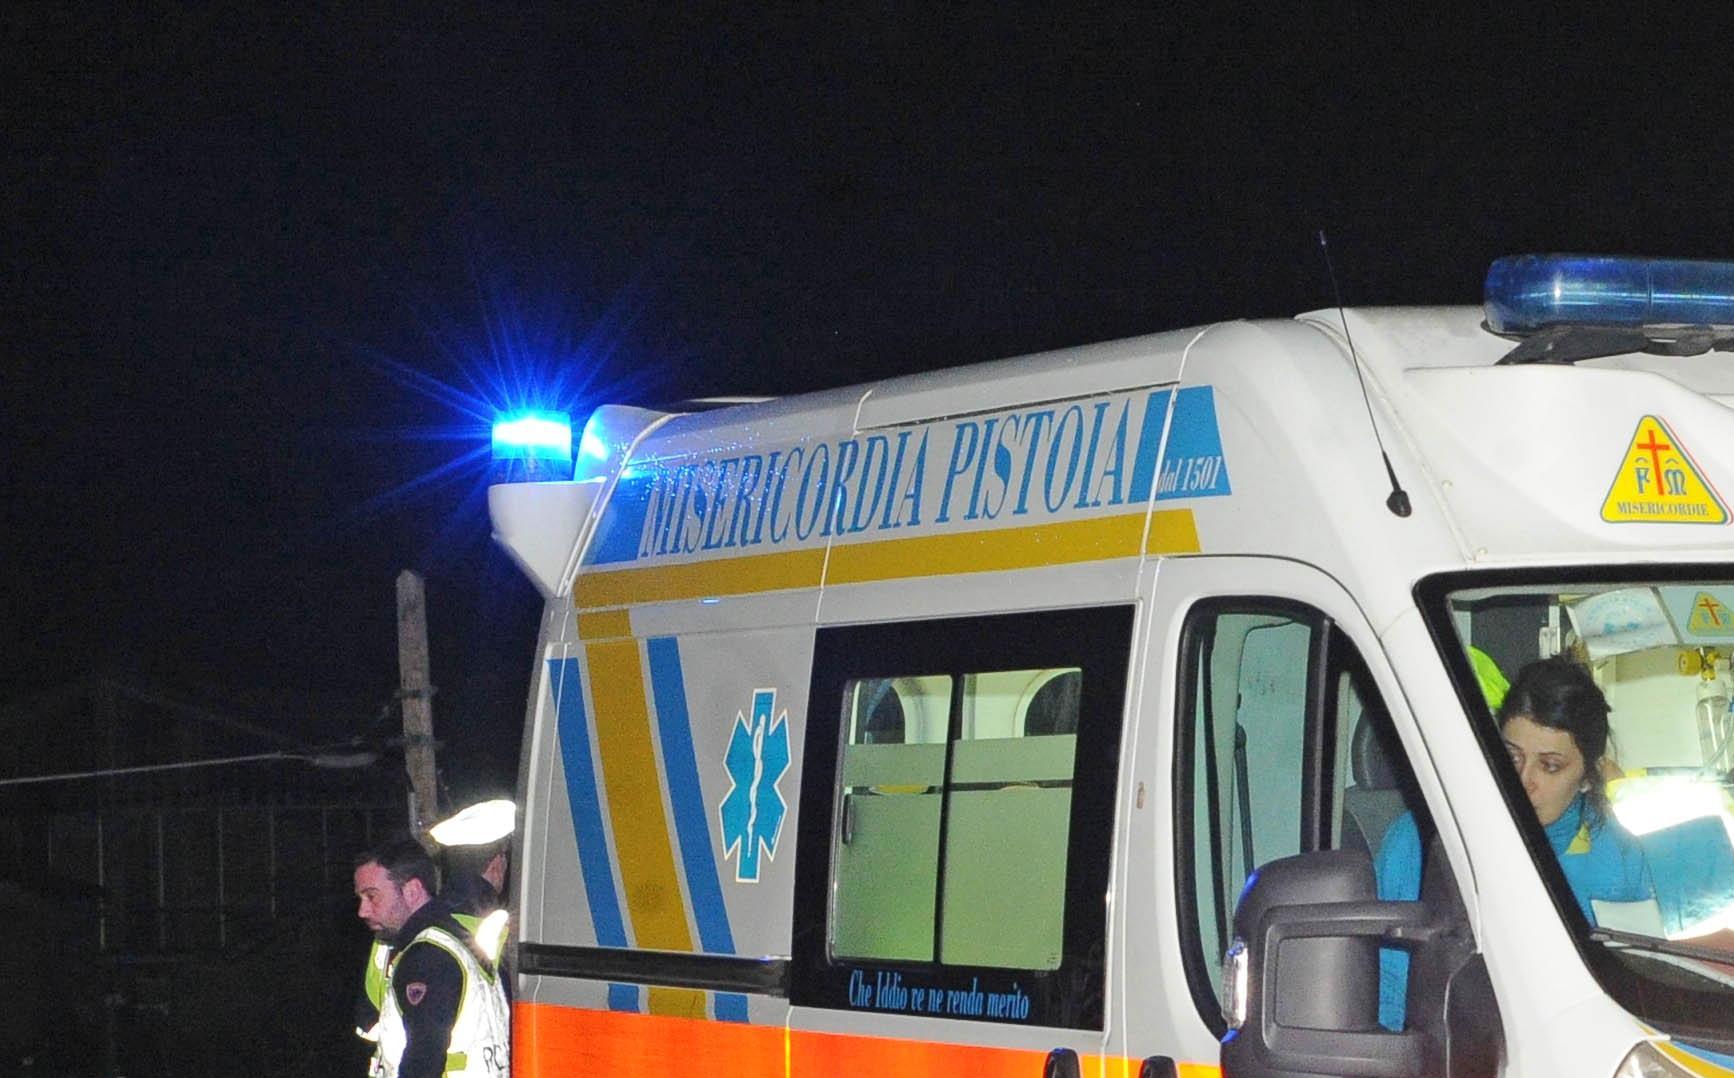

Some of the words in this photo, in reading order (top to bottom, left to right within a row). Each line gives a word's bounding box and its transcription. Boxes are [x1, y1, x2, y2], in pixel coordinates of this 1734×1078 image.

[640, 426, 933, 558] MISERICORDIA
[934, 398, 1133, 525] PISTOIA
[1157, 459, 1183, 494] dal
[1181, 455, 1222, 491] 1501
[849, 969, 873, 1008] Che
[875, 971, 908, 1010] Iddio
[928, 988, 944, 1014] ne
[946, 976, 984, 1016] renda
[986, 981, 1030, 1020] merito
